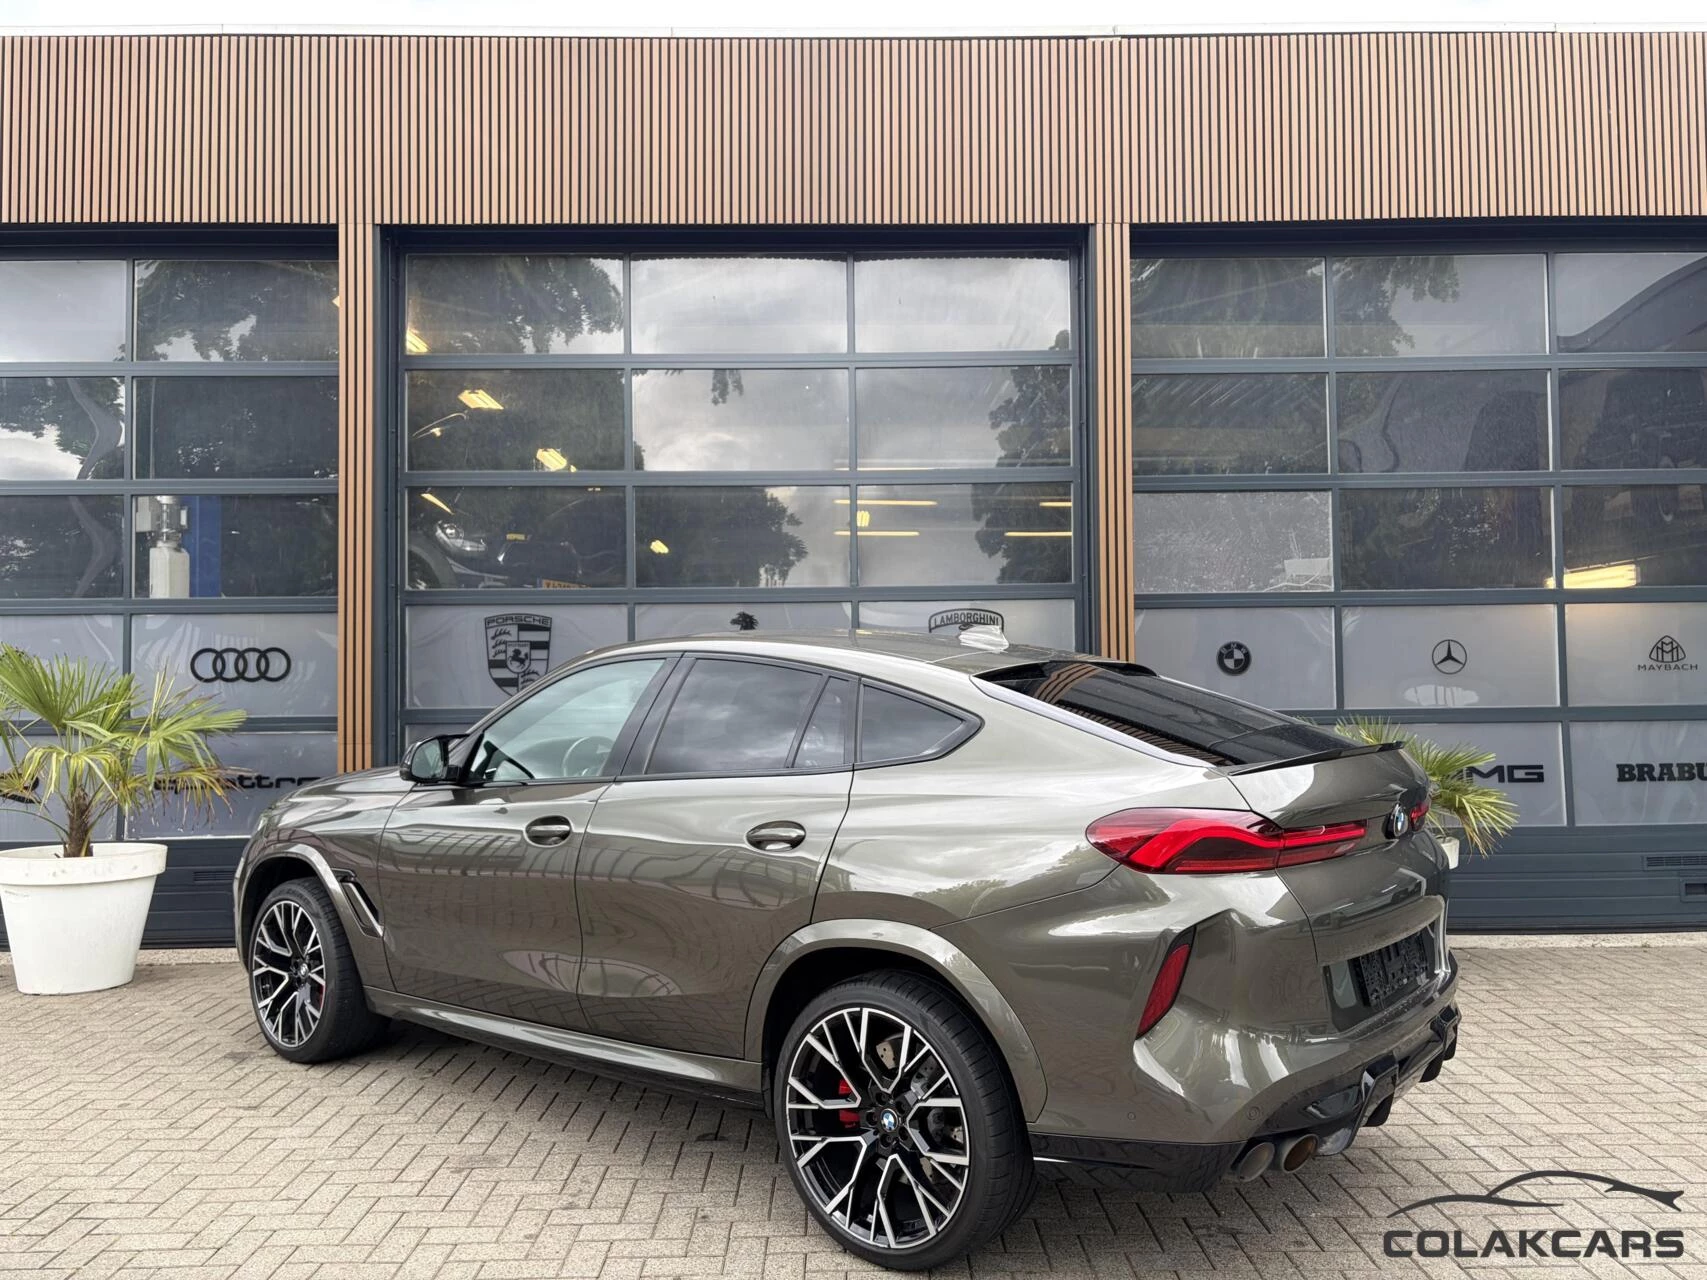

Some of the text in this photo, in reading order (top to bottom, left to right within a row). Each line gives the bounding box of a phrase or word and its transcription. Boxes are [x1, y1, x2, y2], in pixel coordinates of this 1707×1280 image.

[486, 615, 550, 625] PORSCHE
[934, 611, 999, 626] LAMBORGHINI
[1637, 663, 1698, 671] MAYBACH
